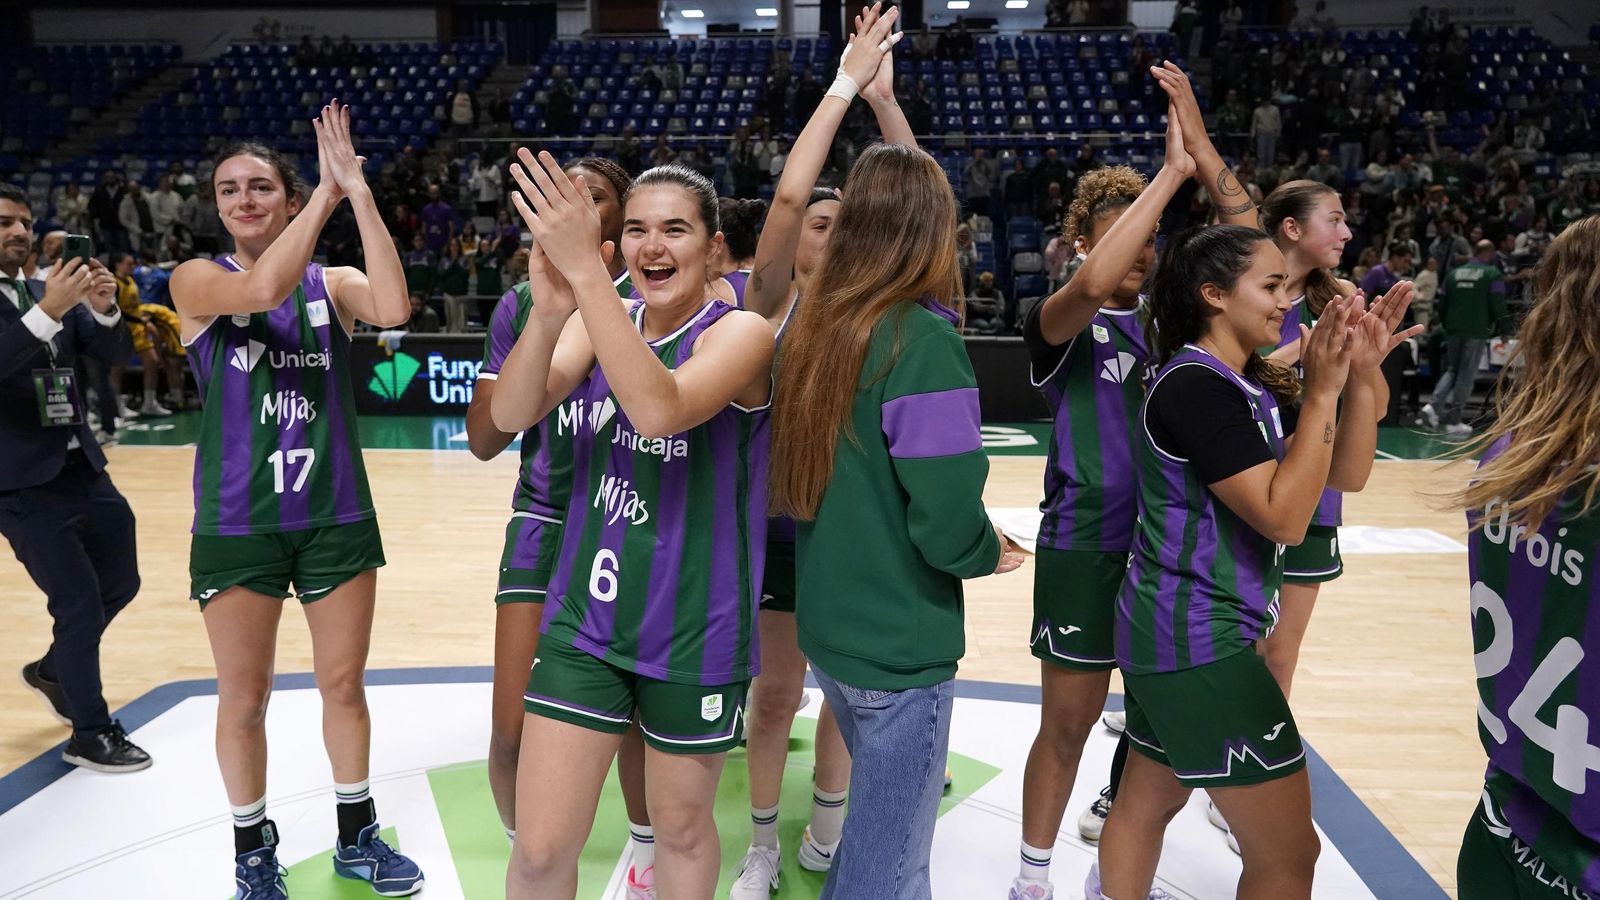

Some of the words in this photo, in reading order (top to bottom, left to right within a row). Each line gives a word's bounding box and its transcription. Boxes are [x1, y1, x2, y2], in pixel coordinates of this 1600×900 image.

[269, 348, 333, 371] Unicaj
[260, 390, 317, 431] Mijas
[267, 447, 316, 494] 17
[593, 473, 649, 526] Mijas
[588, 548, 619, 603] 6
[1470, 581, 1600, 795] 24
